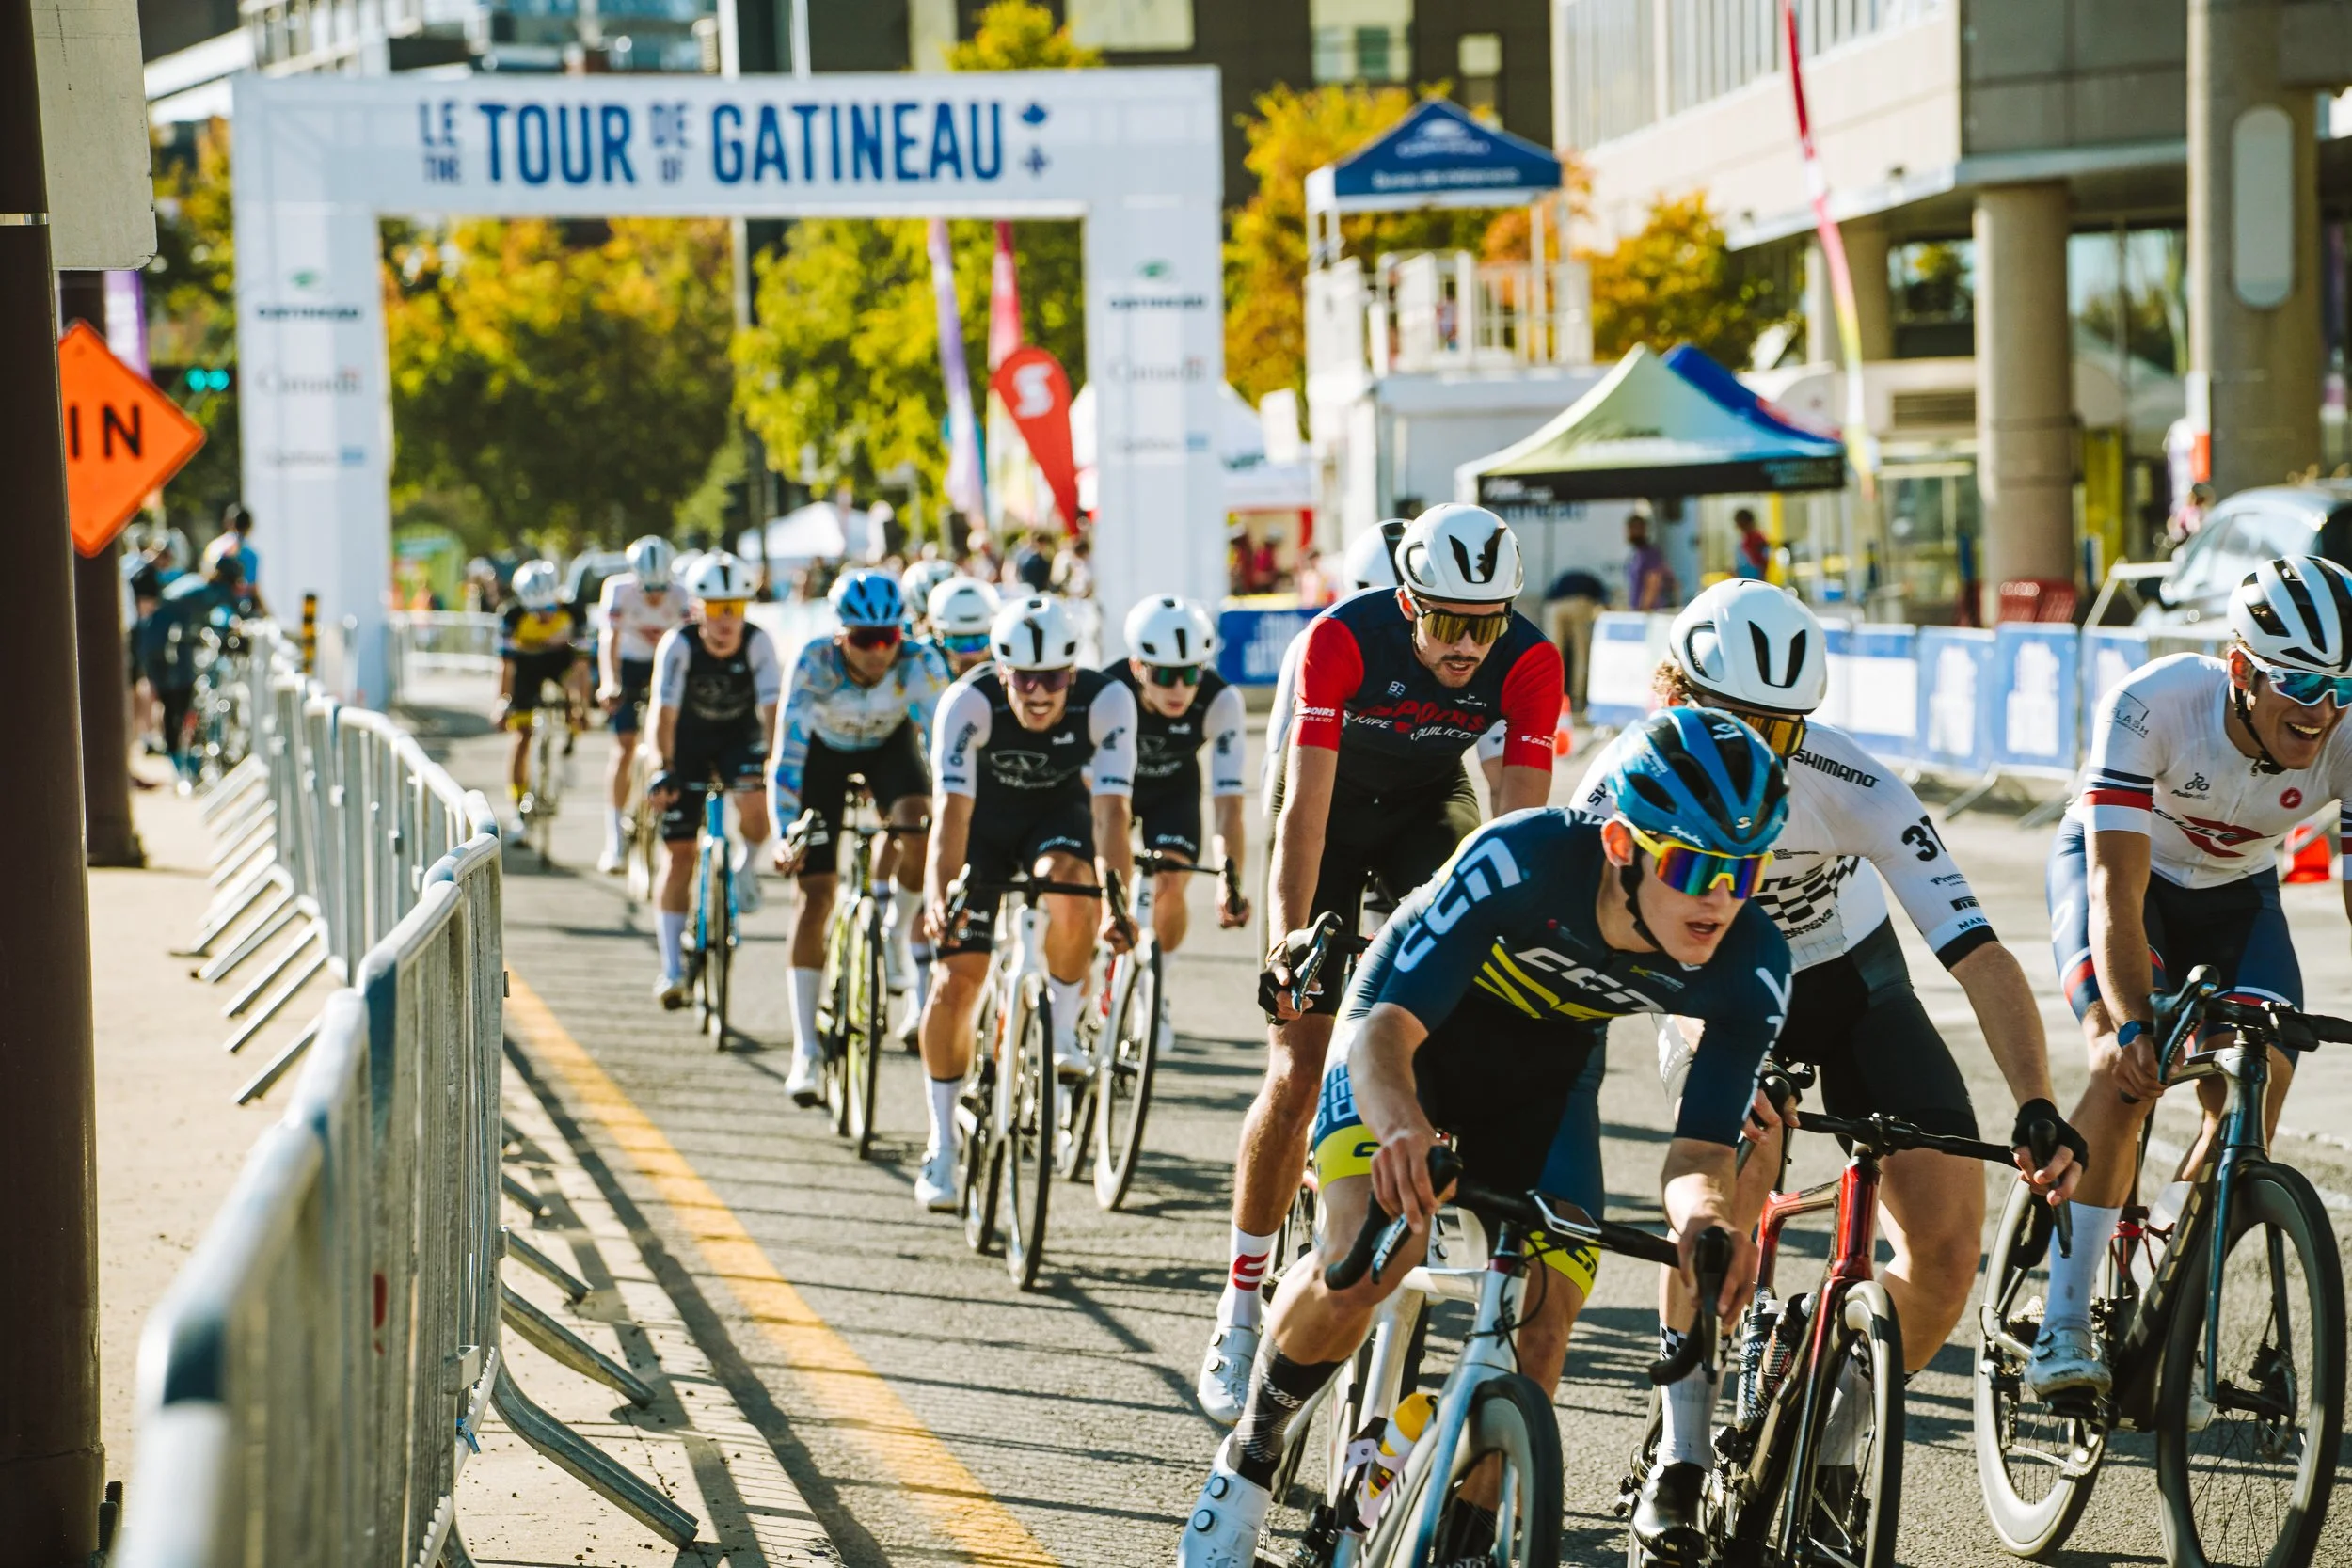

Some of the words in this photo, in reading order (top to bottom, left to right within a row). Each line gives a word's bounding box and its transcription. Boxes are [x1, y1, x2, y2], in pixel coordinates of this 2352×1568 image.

[418, 102, 460, 147] LE
[478, 103, 636, 185] TOUR
[650, 102, 691, 149] DE
[712, 103, 1003, 183] GATINEAU
[425, 155, 461, 183] THE
[1793, 749, 1880, 788] SHIMANO
